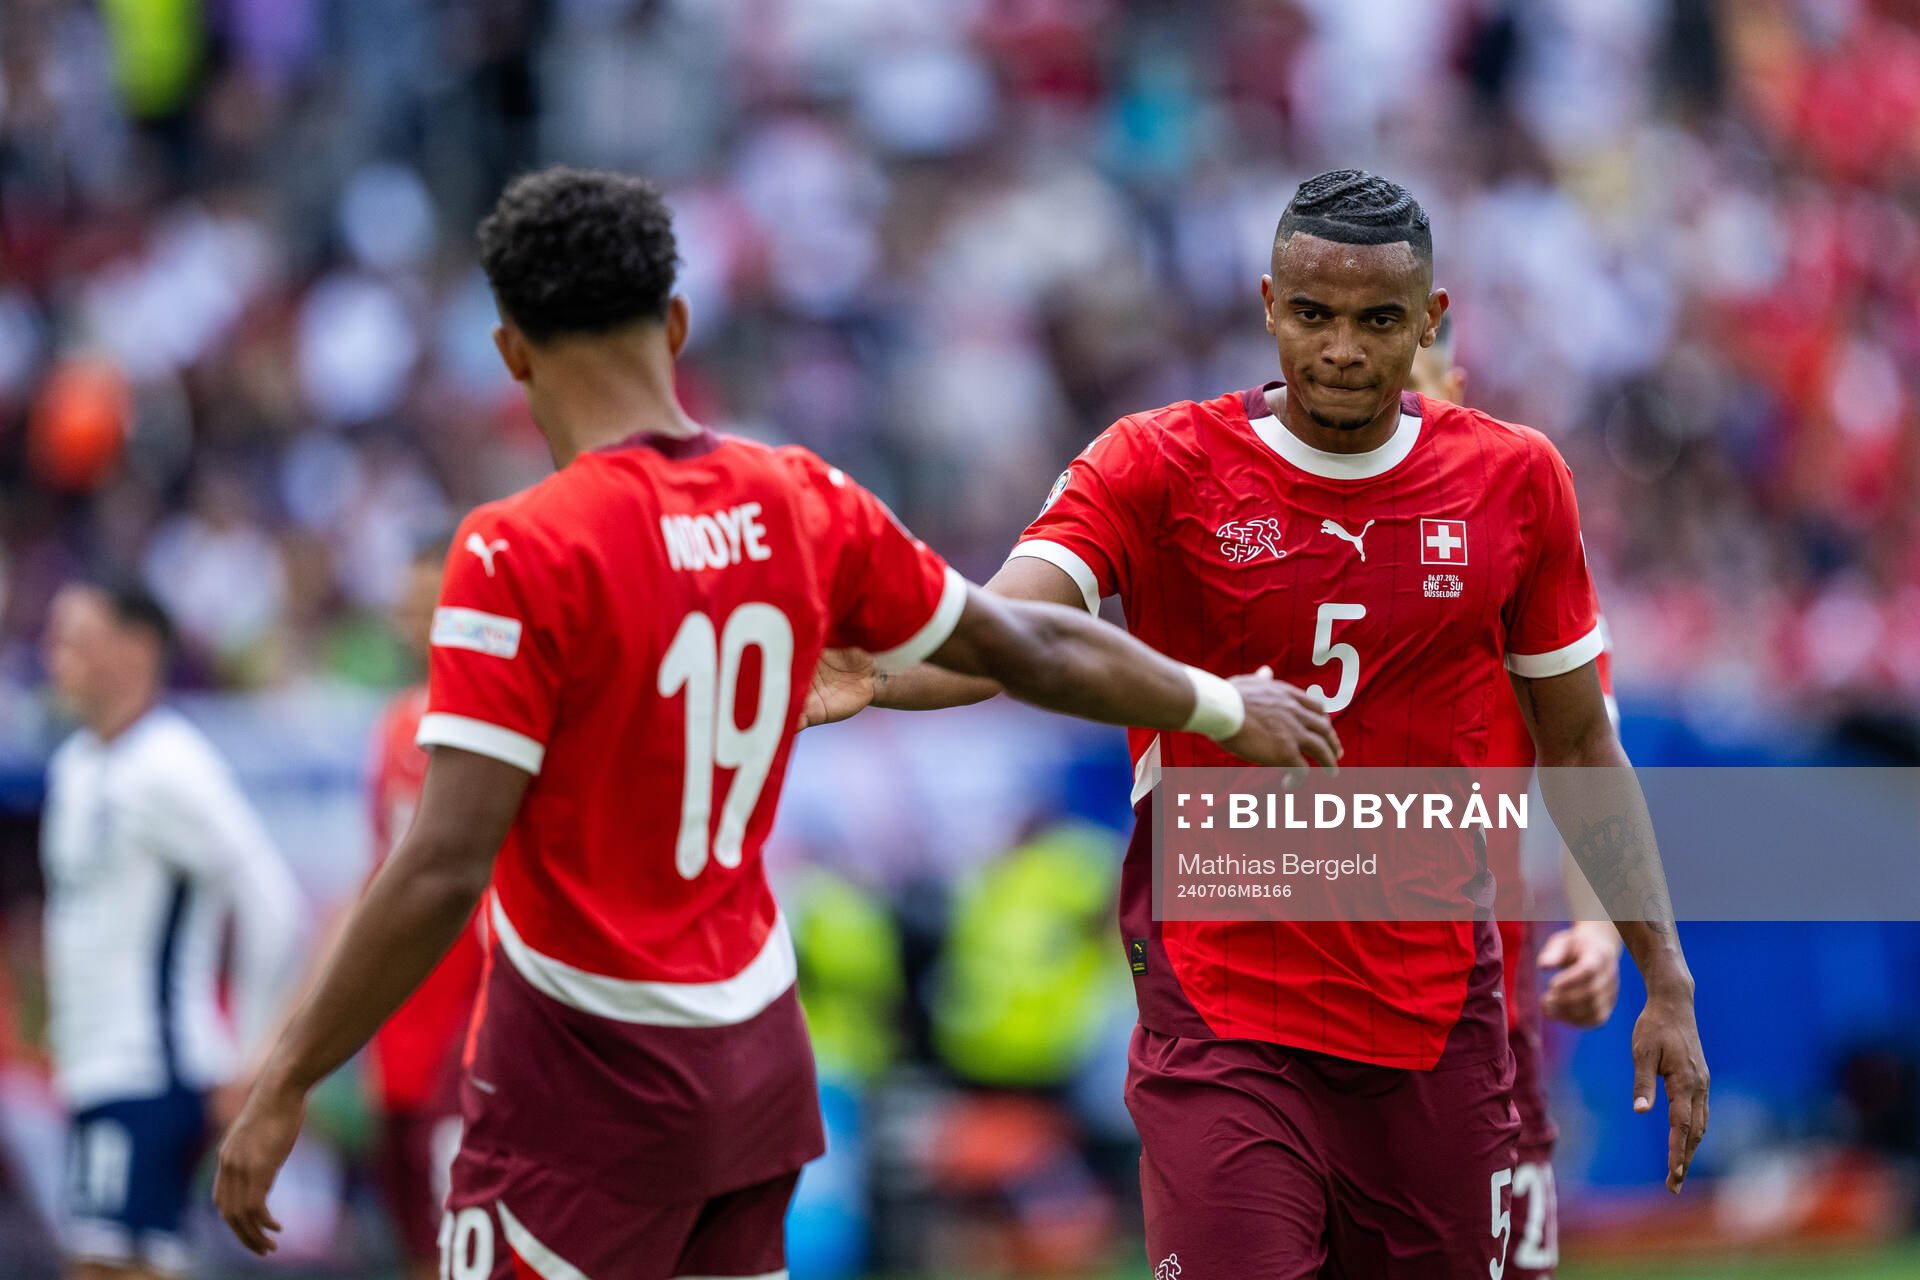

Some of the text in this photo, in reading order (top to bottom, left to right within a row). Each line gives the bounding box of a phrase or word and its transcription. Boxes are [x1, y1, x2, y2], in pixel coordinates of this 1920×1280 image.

[660, 502, 771, 571] NDOYE
[1423, 580, 1439, 590] ENG
[1450, 581, 1464, 591] SUI
[1424, 590, 1460, 598] DÜSSELDORF
[1305, 602, 1367, 714] 5
[658, 602, 793, 880] 19
[1489, 1168, 1512, 1280] 5
